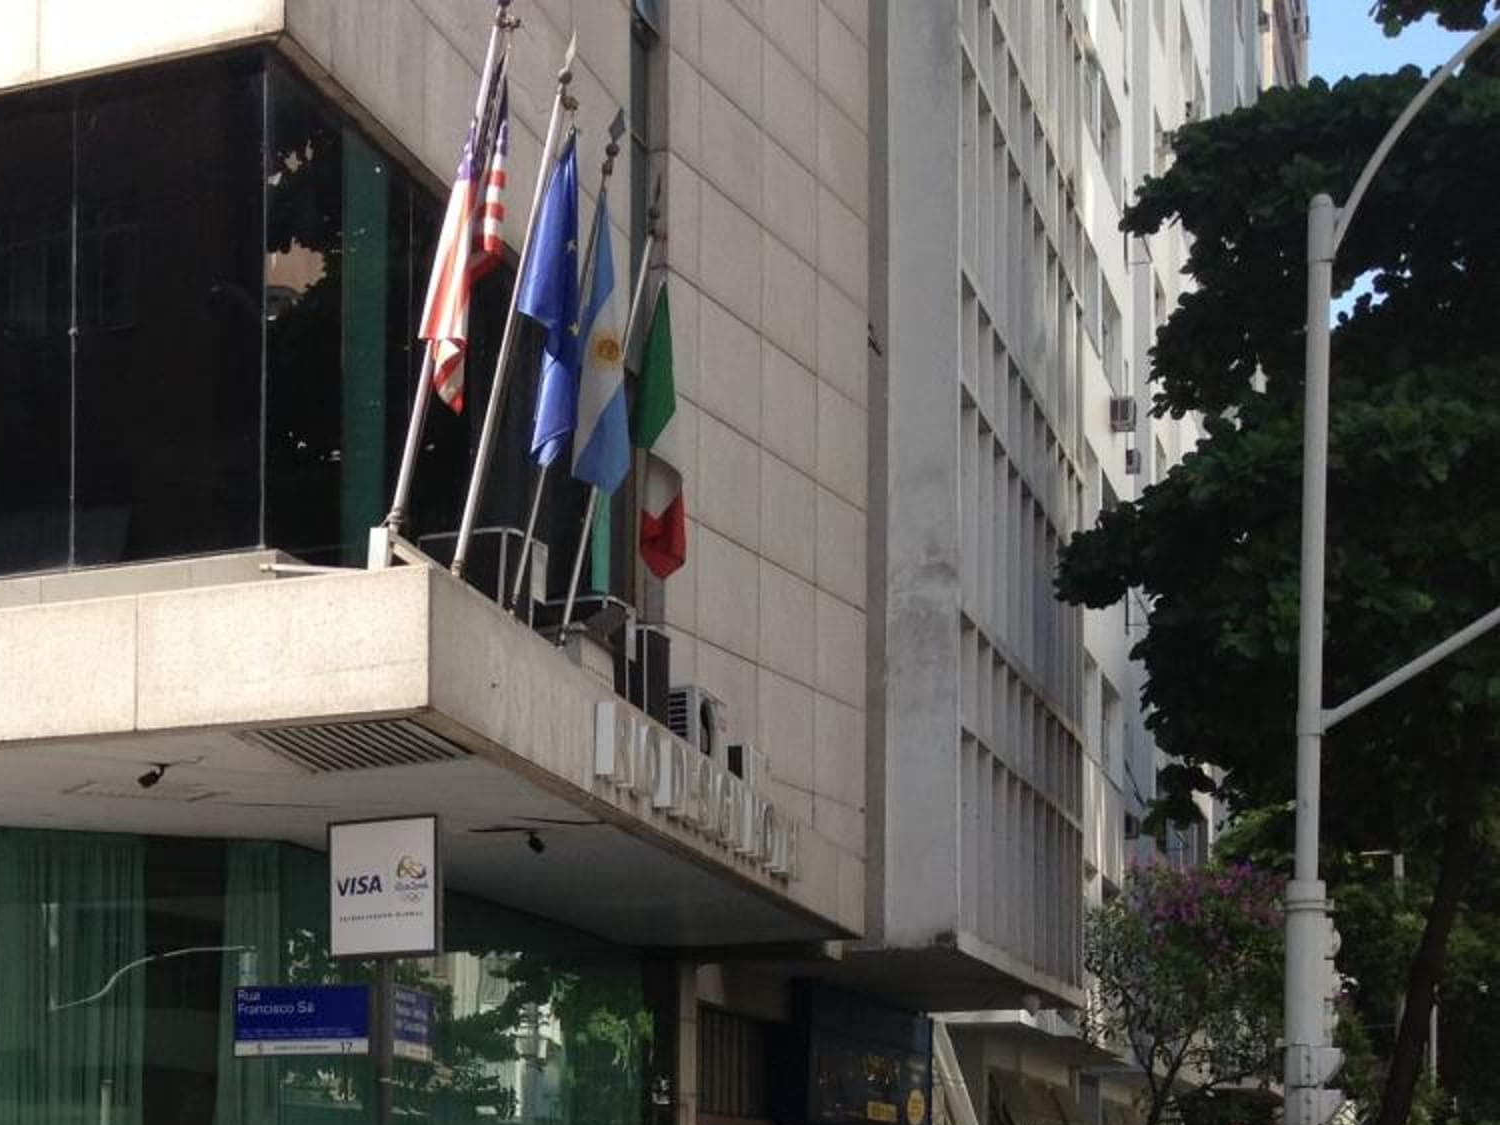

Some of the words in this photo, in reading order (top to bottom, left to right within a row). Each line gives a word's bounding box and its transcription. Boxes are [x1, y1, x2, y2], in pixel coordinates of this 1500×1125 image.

[337, 875, 382, 896] VISA
[237, 989, 261, 1001] Rua
[237, 1003, 294, 1015] Francisco
